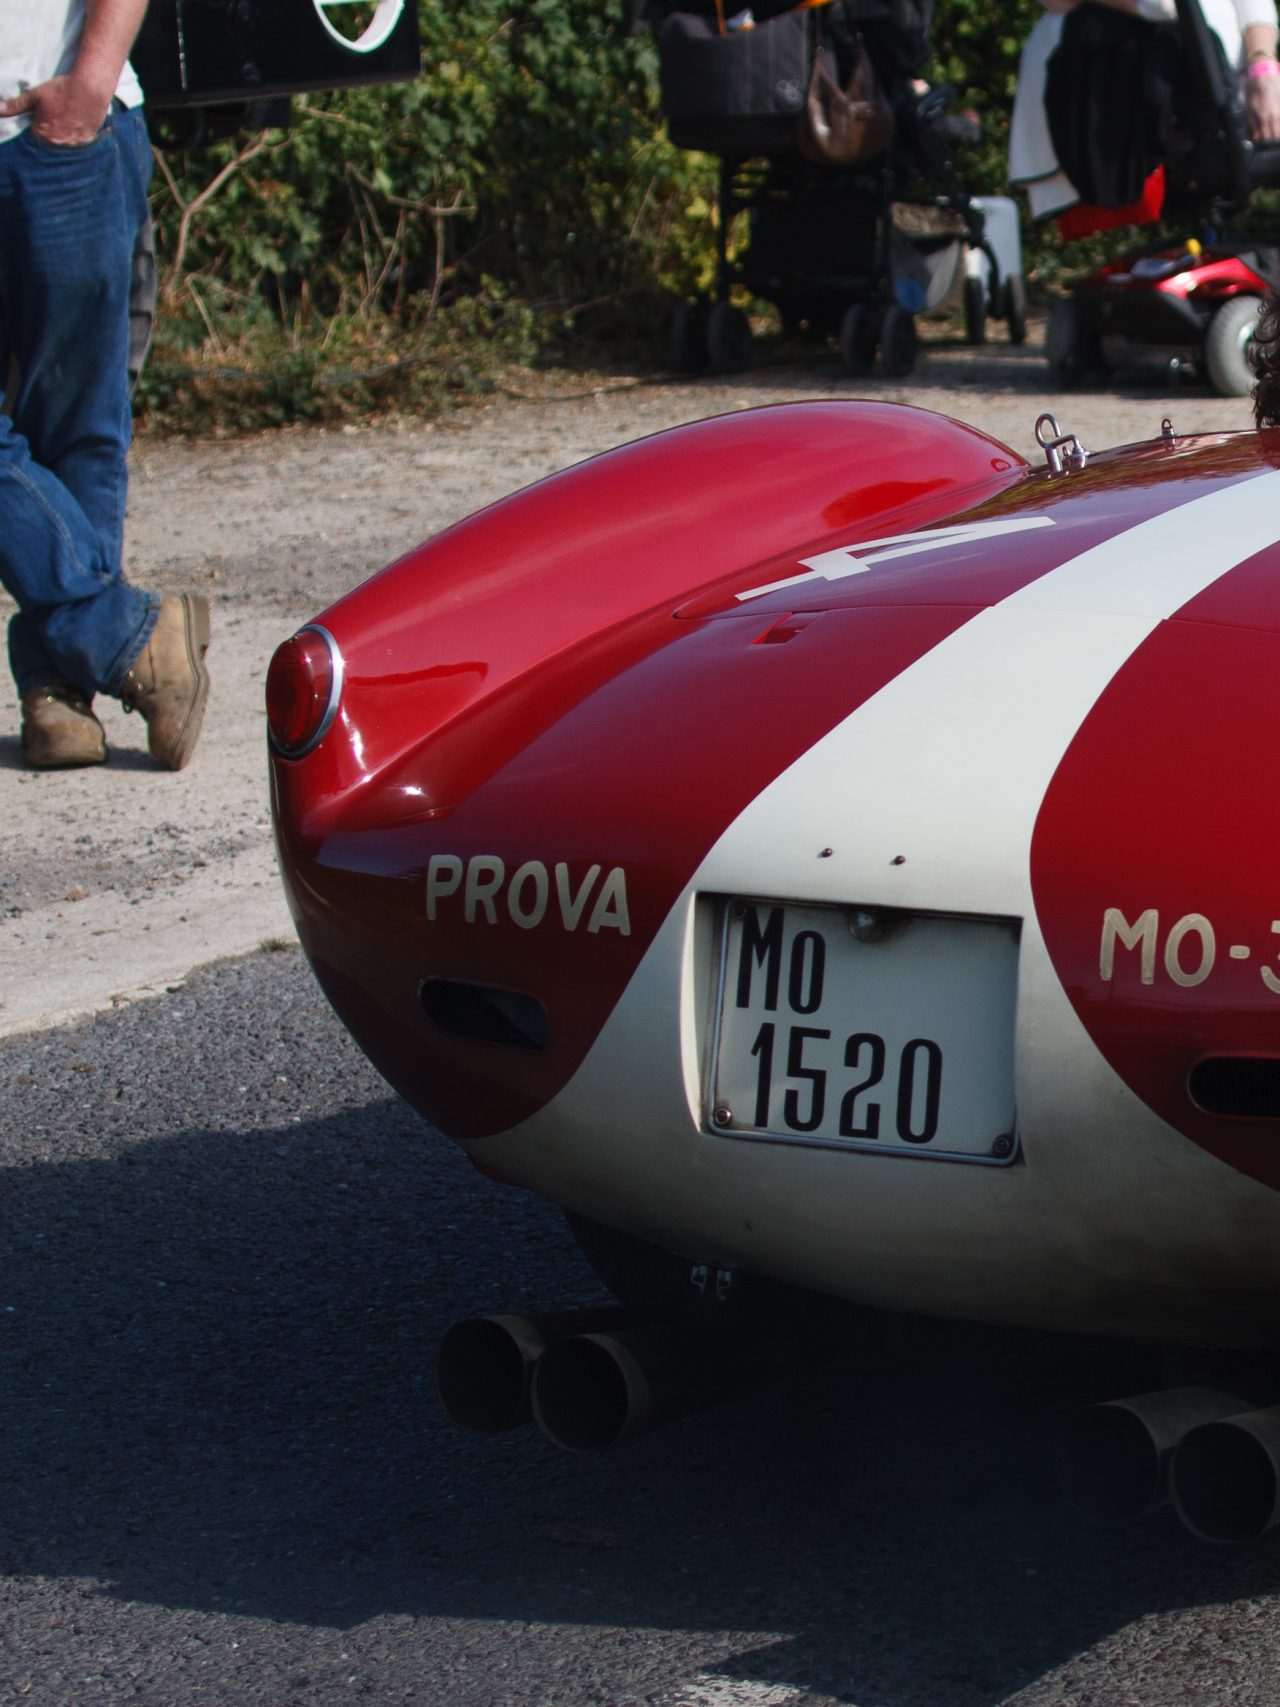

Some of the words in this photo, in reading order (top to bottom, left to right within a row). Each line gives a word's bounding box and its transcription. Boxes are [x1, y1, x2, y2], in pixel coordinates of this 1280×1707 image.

[426, 854, 632, 937] PROVA
[736, 906, 826, 1015] MO
[751, 1022, 943, 1144] 1520
